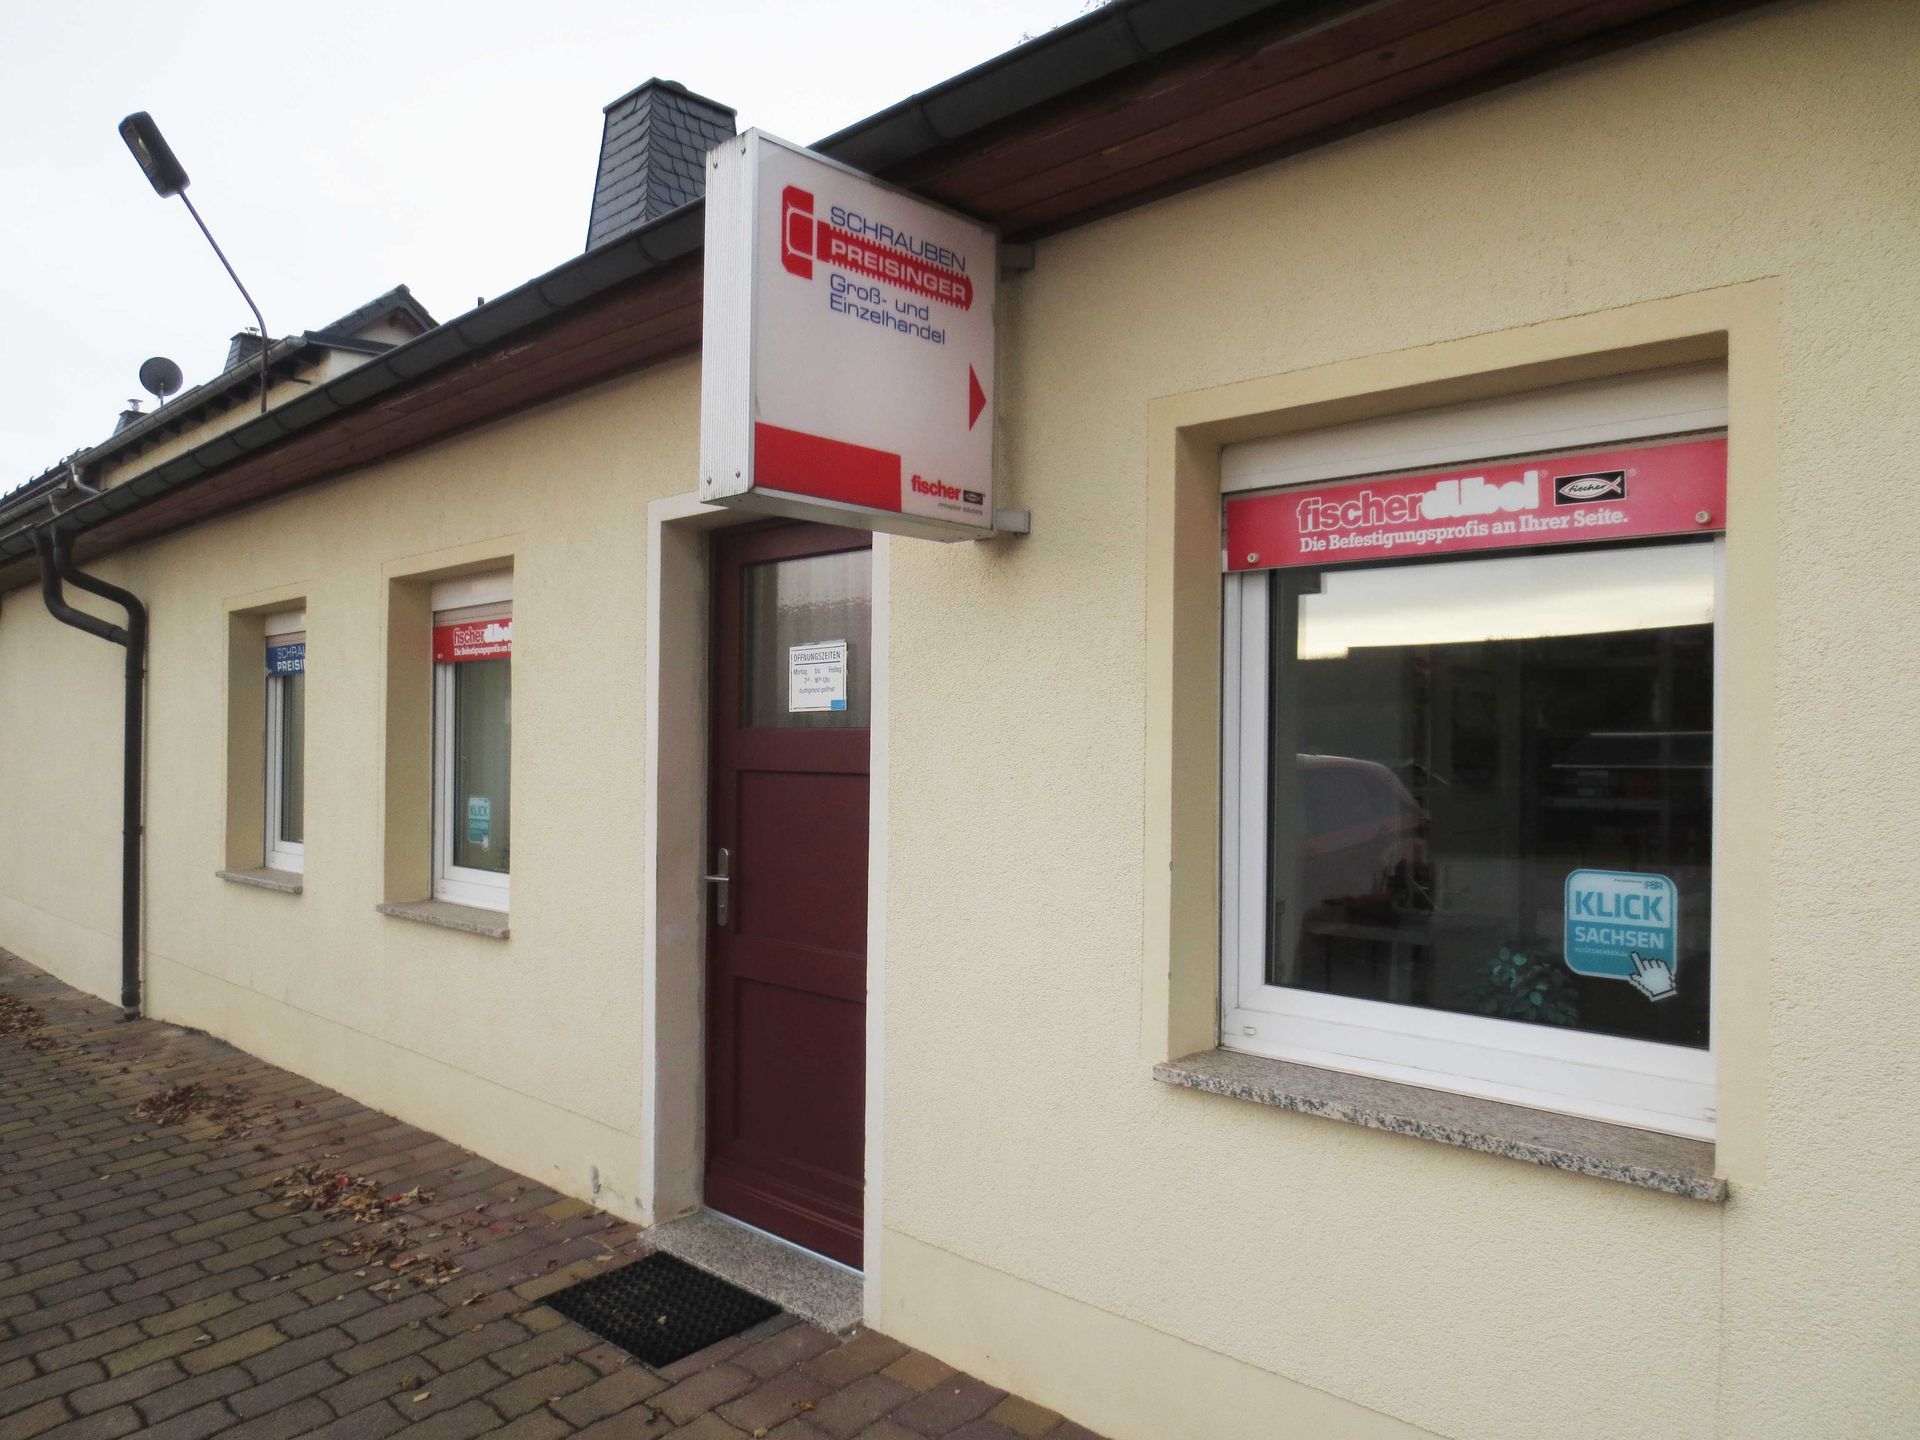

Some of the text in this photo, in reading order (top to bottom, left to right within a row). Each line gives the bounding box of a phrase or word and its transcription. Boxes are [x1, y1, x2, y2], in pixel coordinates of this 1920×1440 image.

[830, 206, 966, 272] SCHRAUBEN
[831, 238, 966, 302] PREISINGER
[830, 273, 929, 321] Groß- und
[830, 293, 945, 345] Einzelhandel
[911, 474, 961, 501] fischer
[1567, 483, 1607, 494] fischer
[1300, 507, 1628, 553] Die Befestigungsprofis an Ihrer Seite.
[1575, 890, 1664, 922] KLICK
[1575, 926, 1665, 950] SACHSEN
